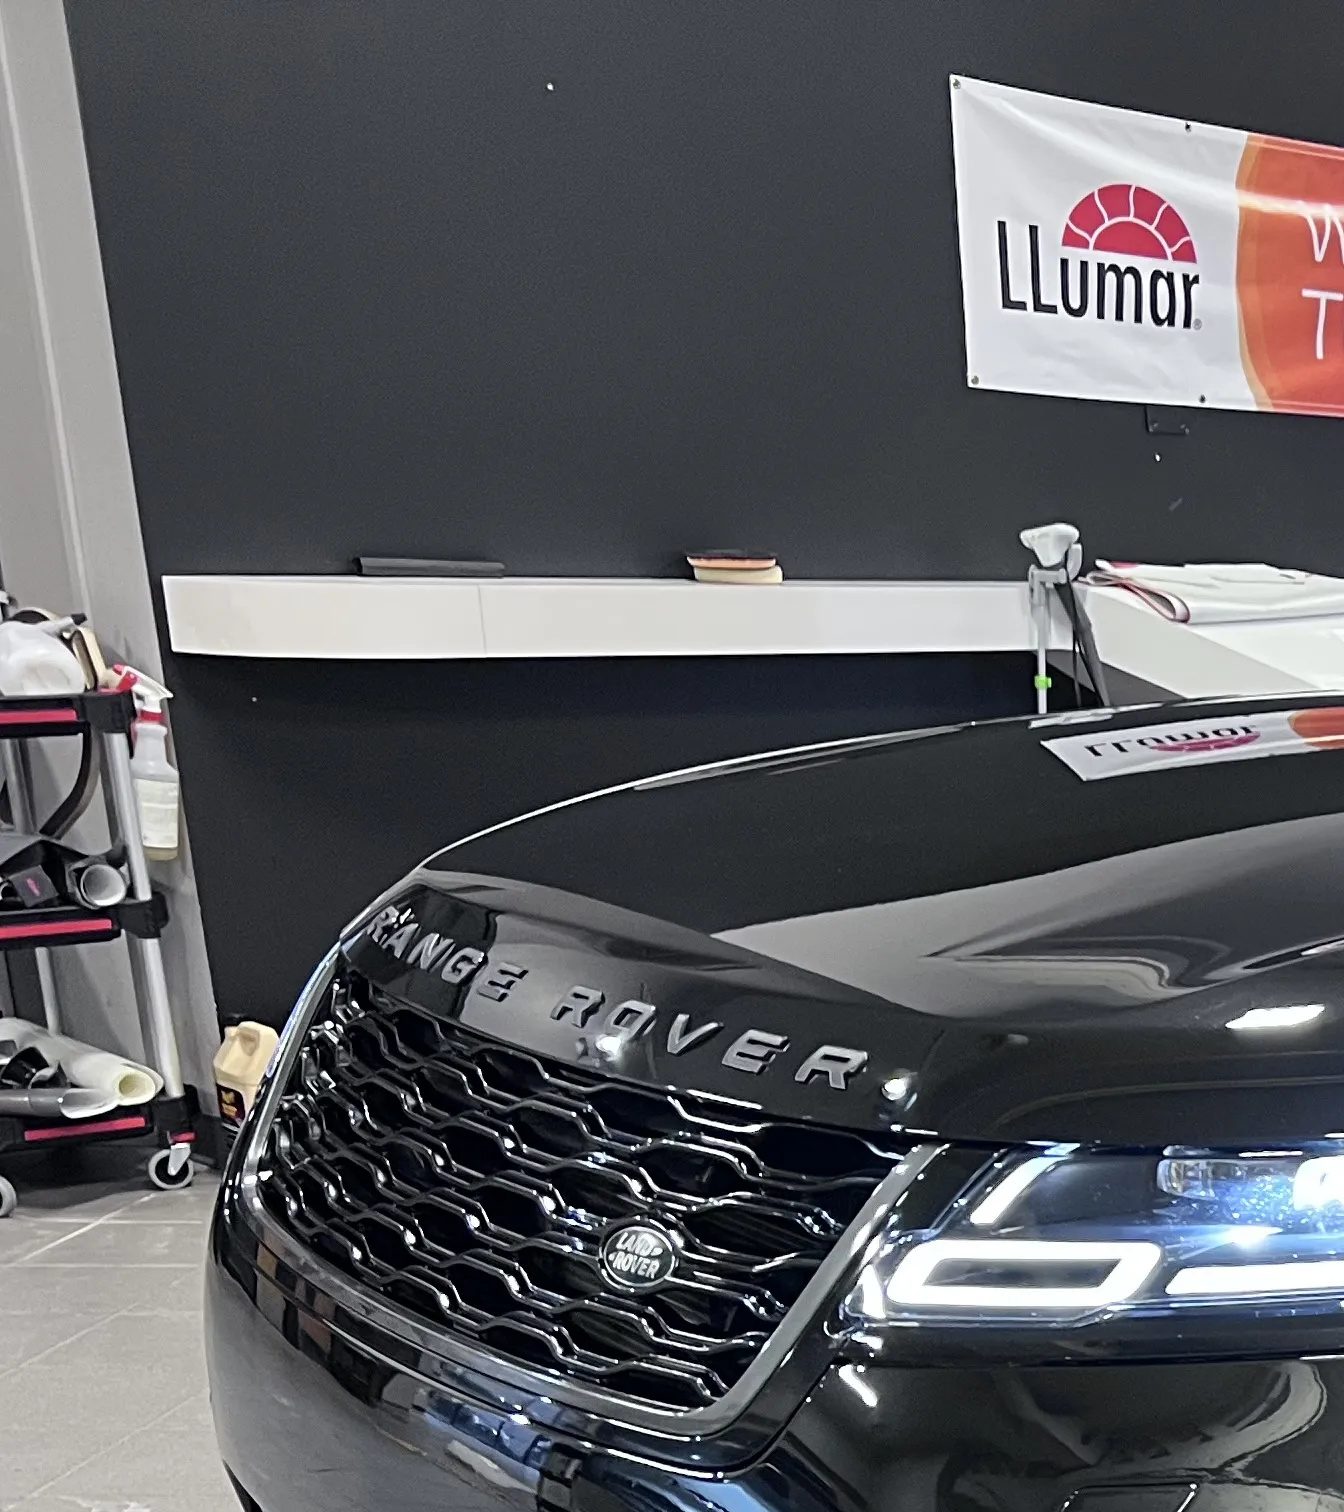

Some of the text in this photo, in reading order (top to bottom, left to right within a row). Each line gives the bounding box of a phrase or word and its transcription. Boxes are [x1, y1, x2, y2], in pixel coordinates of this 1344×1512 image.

[997, 220, 1200, 329] LLumar
[366, 904, 869, 1090] RANGE ROVER
[612, 1251, 660, 1280] ROVER
[615, 1231, 656, 1258] LAND
